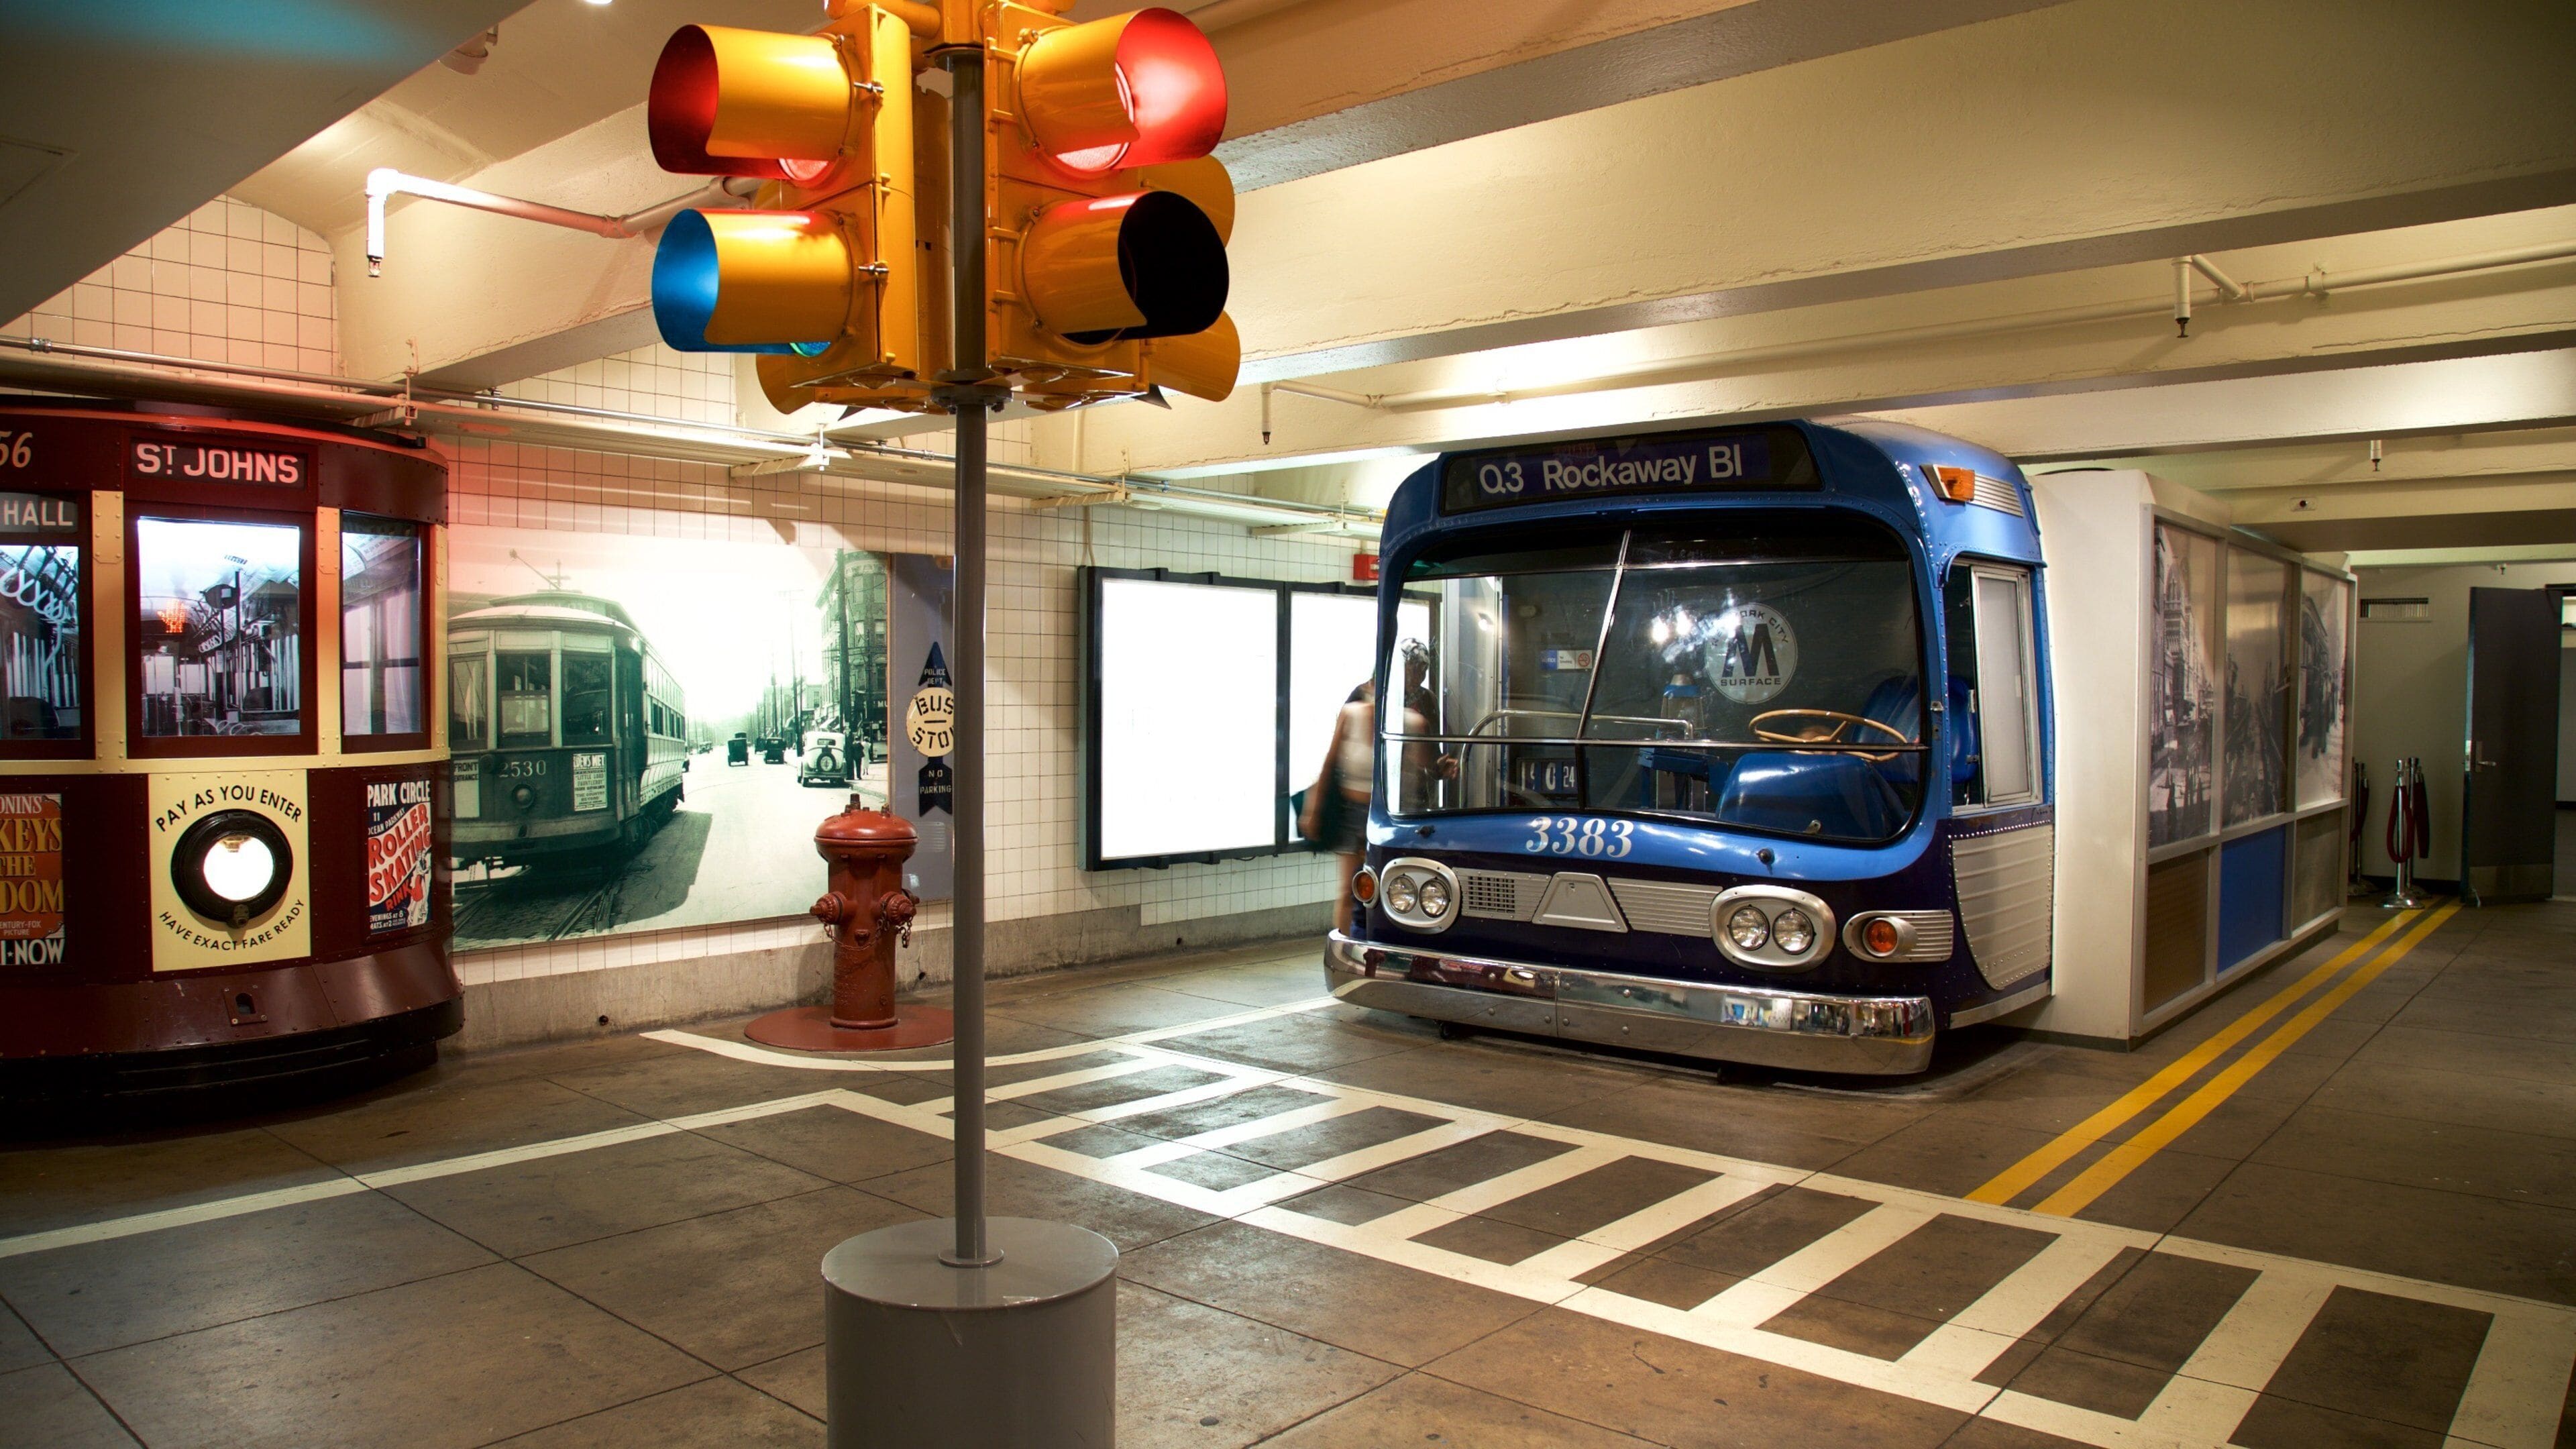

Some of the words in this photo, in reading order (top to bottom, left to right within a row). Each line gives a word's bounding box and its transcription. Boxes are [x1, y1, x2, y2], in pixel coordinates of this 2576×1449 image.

[184, 447, 299, 484] JOHNS
[1480, 462, 1524, 494] Q3
[1543, 455, 1697, 490] Rockaway
[3, 500, 73, 527] HALL
[1768, 617, 1789, 643] CITY
[1720, 677, 1782, 686] SURFACE
[498, 760, 546, 777] 2530
[928, 769, 943, 777] NO
[367, 784, 397, 808] PARK
[400, 780, 431, 804] CIRCLE
[920, 785, 951, 794] PARKING
[156, 800, 187, 832] PAY
[195, 790, 214, 809] AS
[220, 785, 255, 801] YOU
[260, 790, 301, 822] ENTER
[384, 807, 405, 828] PARKWAY
[368, 804, 429, 869] ROLLER
[1526, 816, 1634, 858] 3383
[370, 825, 431, 902] SKATING
[160, 912, 193, 940] HAVE
[193, 935, 237, 950] EXACT
[242, 931, 273, 949] FARE
[274, 899, 305, 934] READY
[15, 939, 65, 965] NOW
